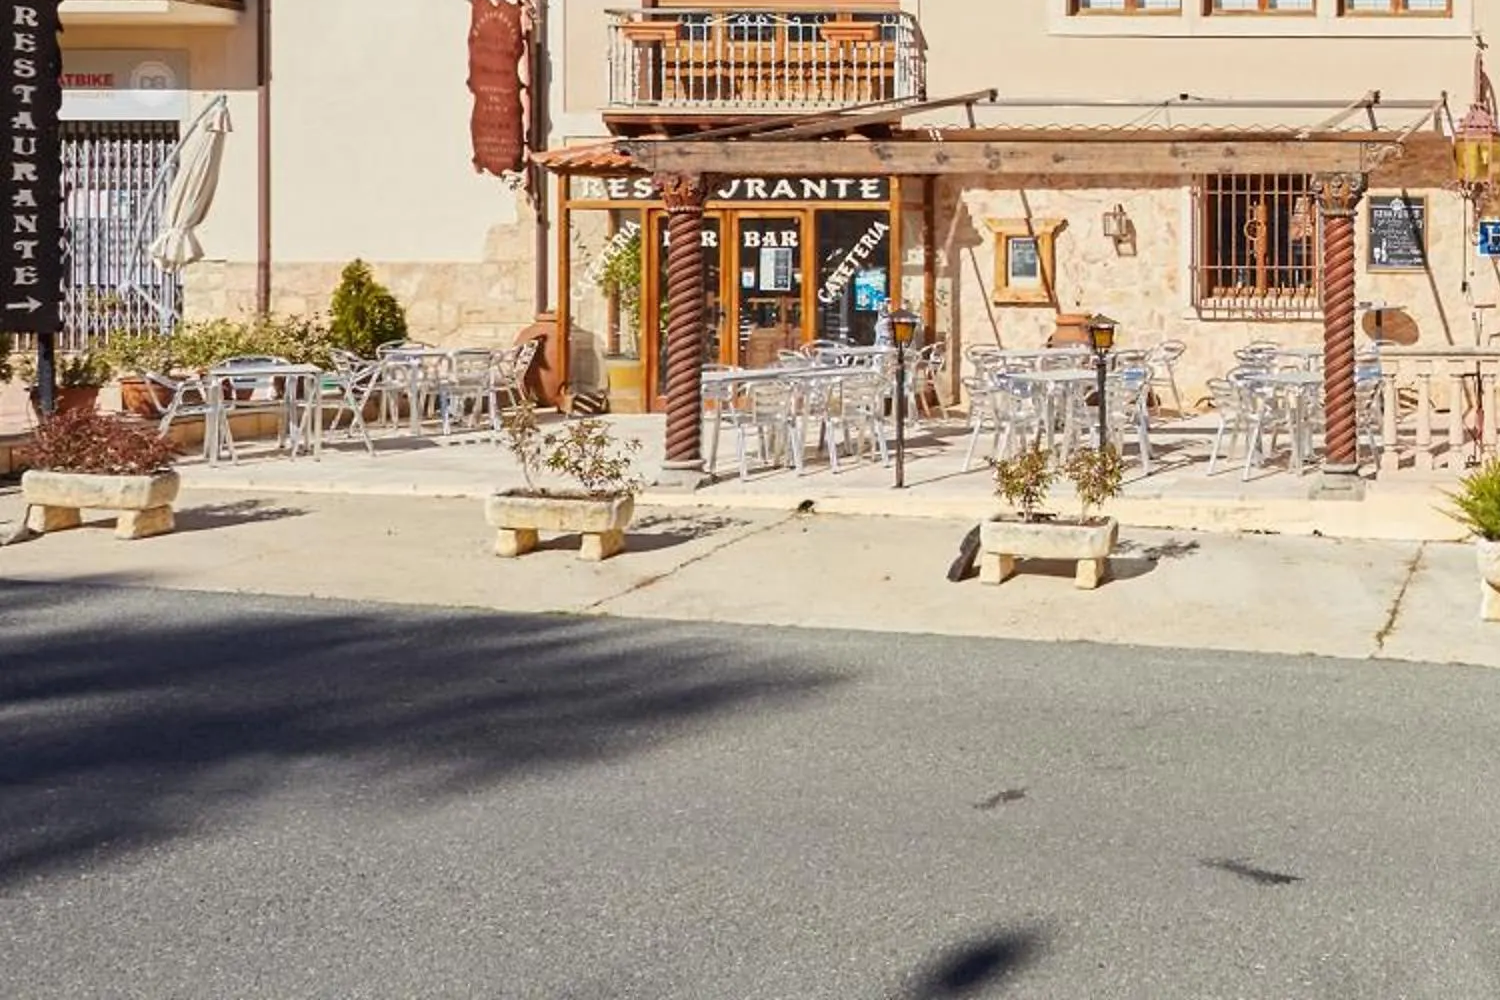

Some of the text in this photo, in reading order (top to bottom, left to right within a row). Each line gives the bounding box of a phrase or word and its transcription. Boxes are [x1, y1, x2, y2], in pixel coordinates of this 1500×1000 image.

[57, 73, 114, 87] ATBIKE
[11, 5, 38, 285] RESTAURANTE
[583, 177, 880, 199] RESURANTE
[743, 231, 799, 247] BAR
[817, 221, 890, 304] CAFETERIA
